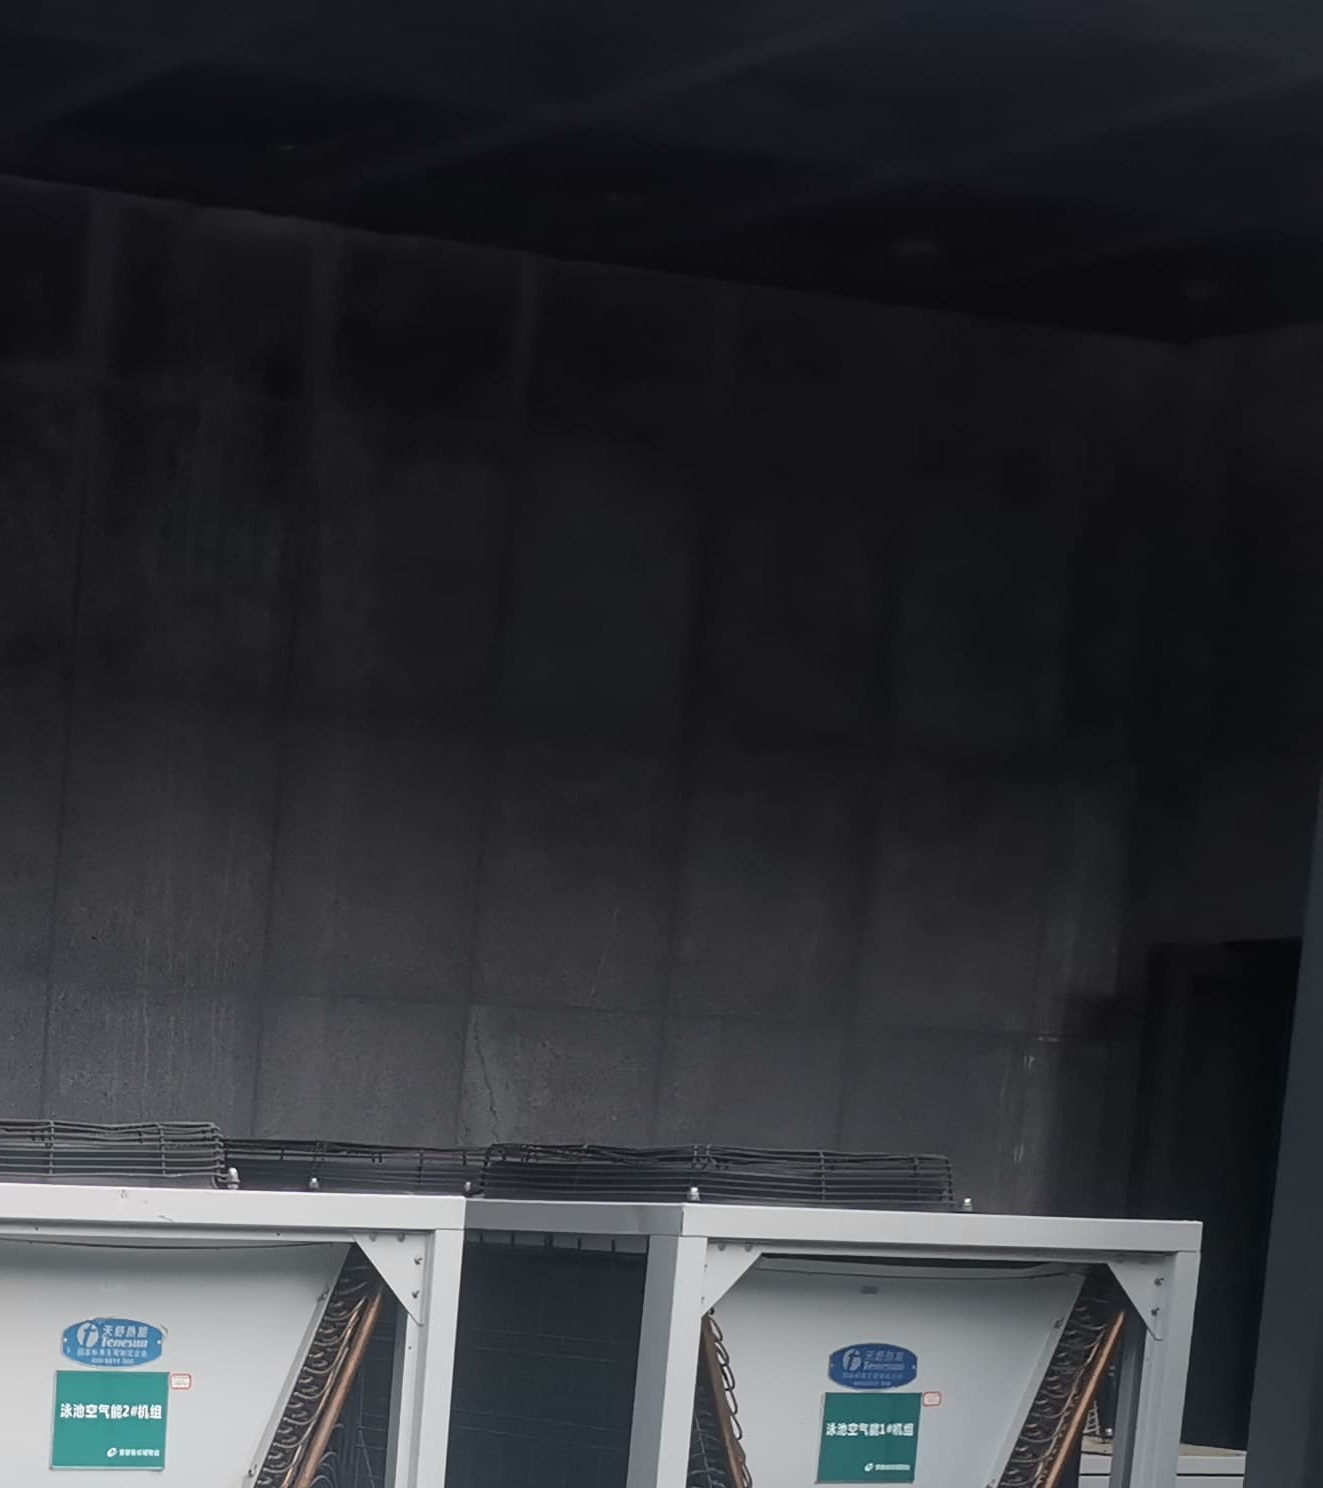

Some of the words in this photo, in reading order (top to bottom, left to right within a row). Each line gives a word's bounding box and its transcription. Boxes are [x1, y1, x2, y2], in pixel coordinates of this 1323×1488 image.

[60, 1404, 162, 1419] 泳池空气能2#机组
